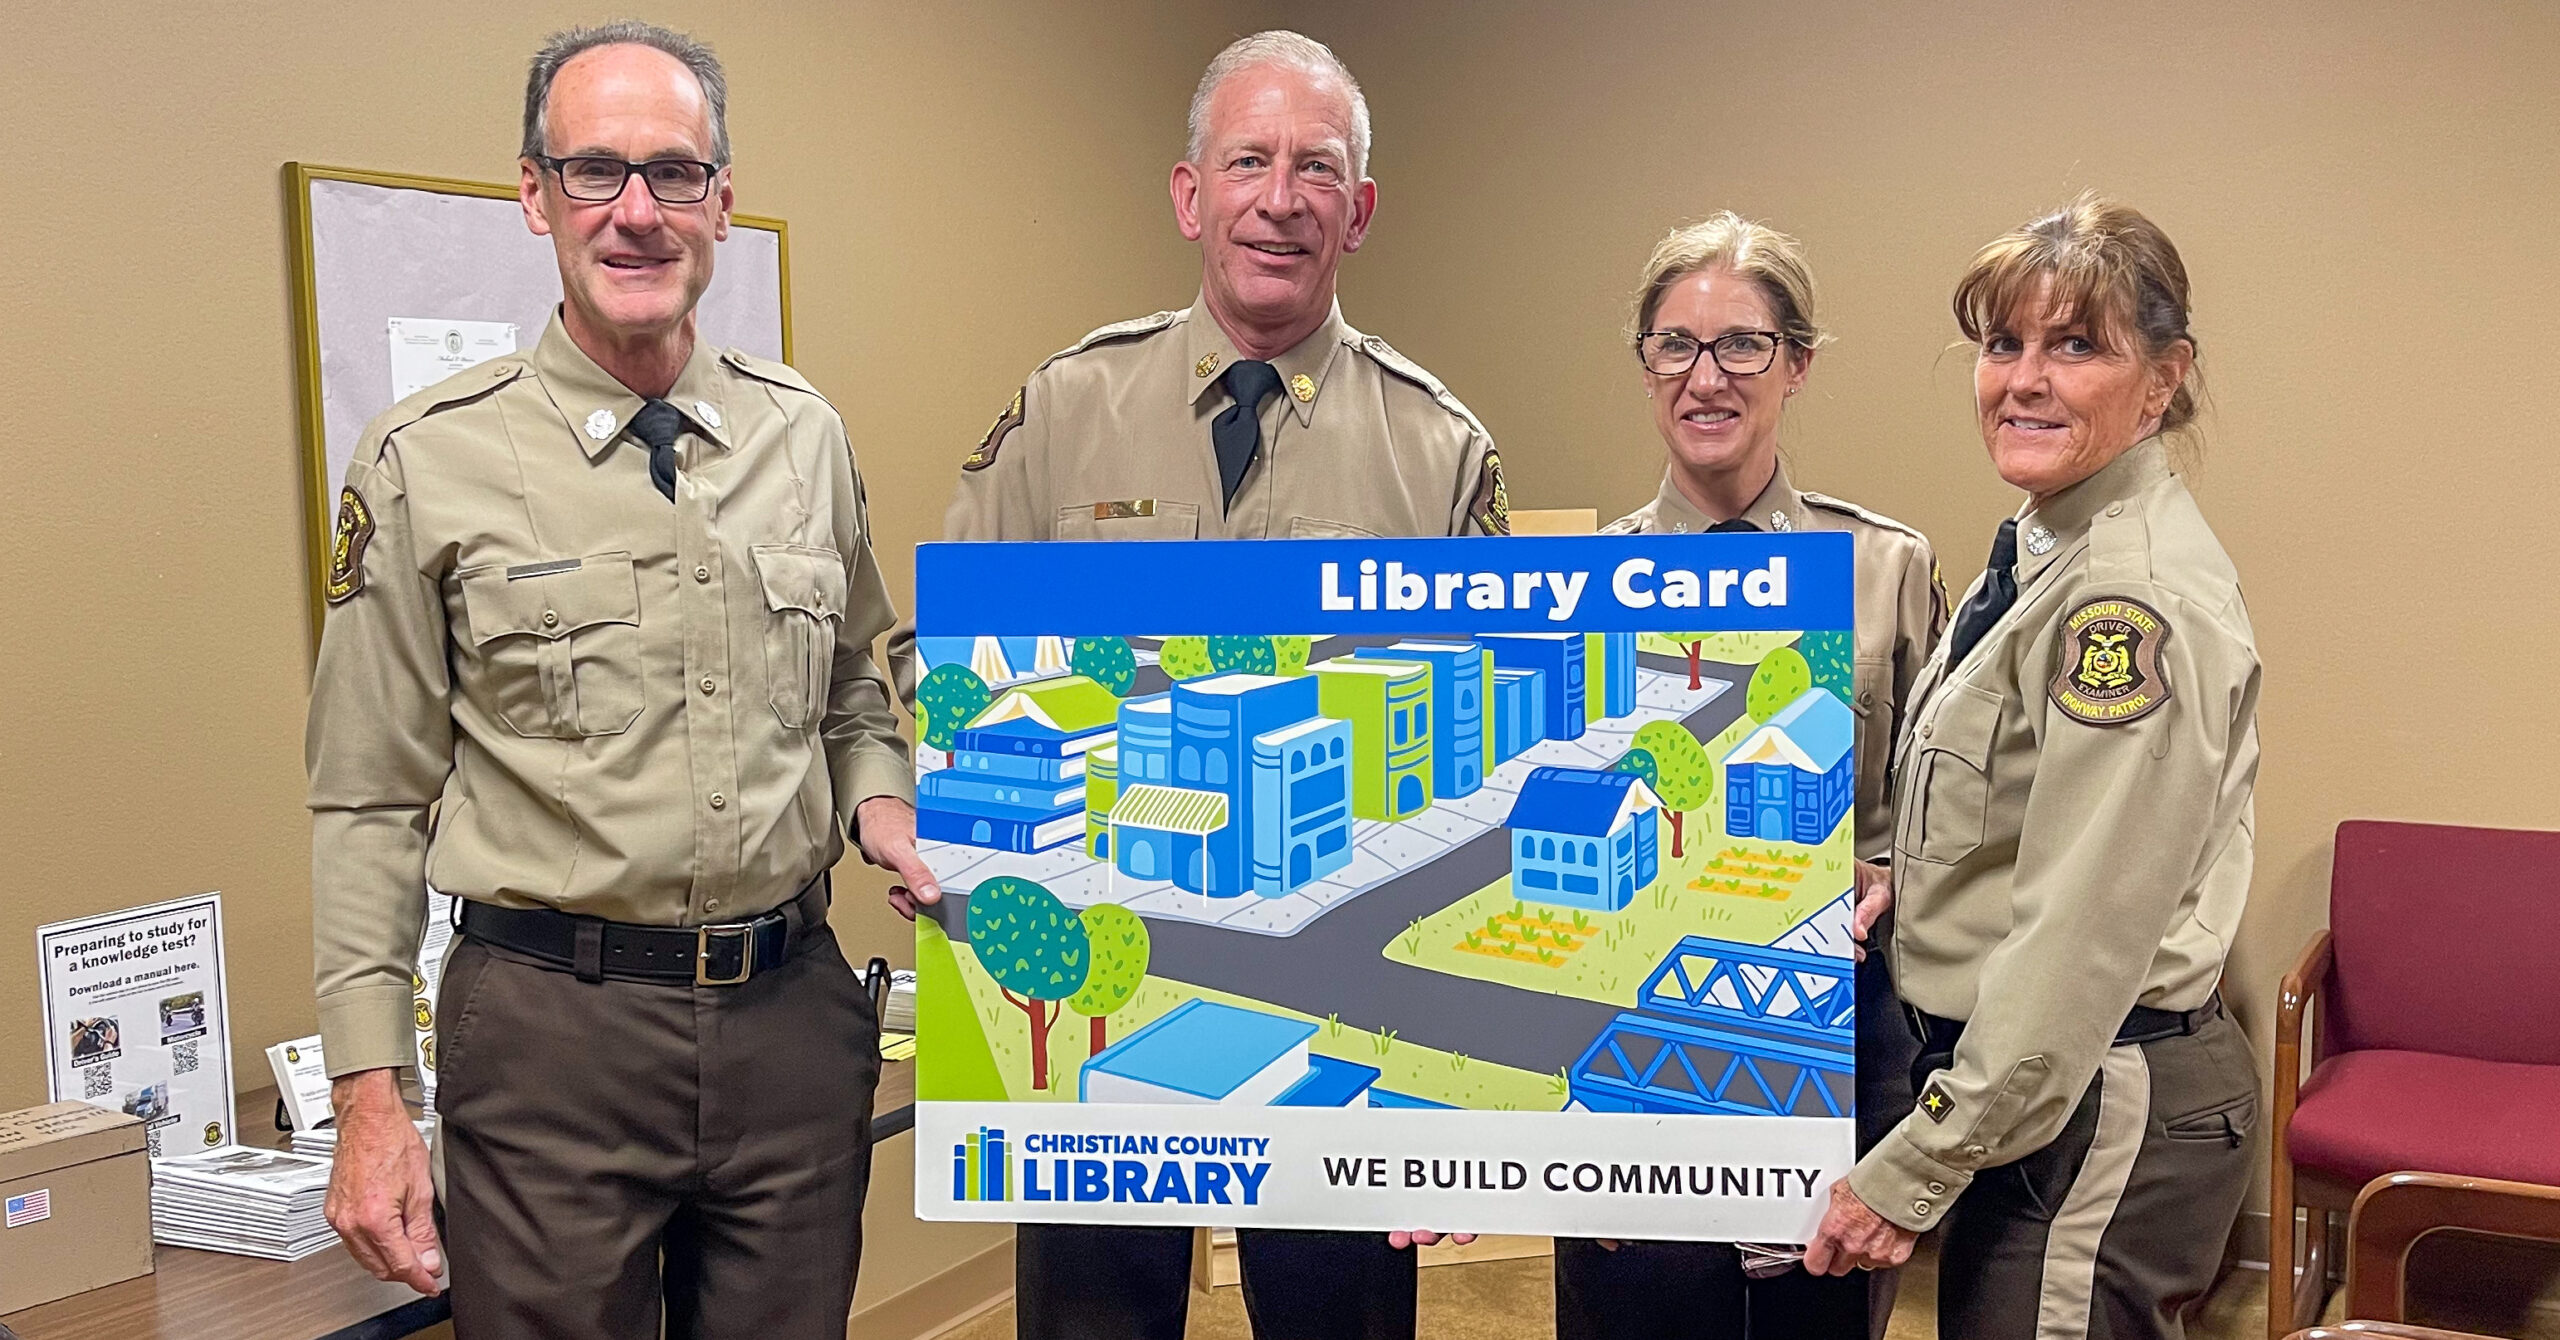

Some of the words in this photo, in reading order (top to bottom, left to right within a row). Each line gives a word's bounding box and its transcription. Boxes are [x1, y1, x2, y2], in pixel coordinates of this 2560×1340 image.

[1320, 558, 1590, 622] Library
[1611, 556, 1788, 609] Card
[2068, 604, 2121, 630] MISSOURI
[2124, 607, 2156, 633] STATE
[2088, 621, 2131, 634] DRIVER
[2059, 690, 2105, 718] HIGHWAY
[2108, 693, 2151, 718] PATROL
[2078, 683, 2130, 698] EXAMINER
[54, 933, 126, 959] Preparing
[129, 931, 143, 943] to
[147, 922, 184, 939] study
[188, 917, 208, 931] for
[69, 961, 77, 972] a
[82, 944, 158, 970] knowledge
[162, 934, 196, 952] test?
[69, 977, 122, 997] Download
[125, 977, 131, 985] a
[134, 966, 172, 982] manual
[174, 961, 200, 974] here.
[1024, 1134, 1158, 1155] CHRISTIAN
[1164, 1136, 1270, 1157] COUNTY
[1023, 1158, 1272, 1205] LIBRARY
[1323, 1157, 1387, 1187] WE
[1403, 1158, 1528, 1191] BUILD
[1543, 1162, 1822, 1199] COMMUNITY
